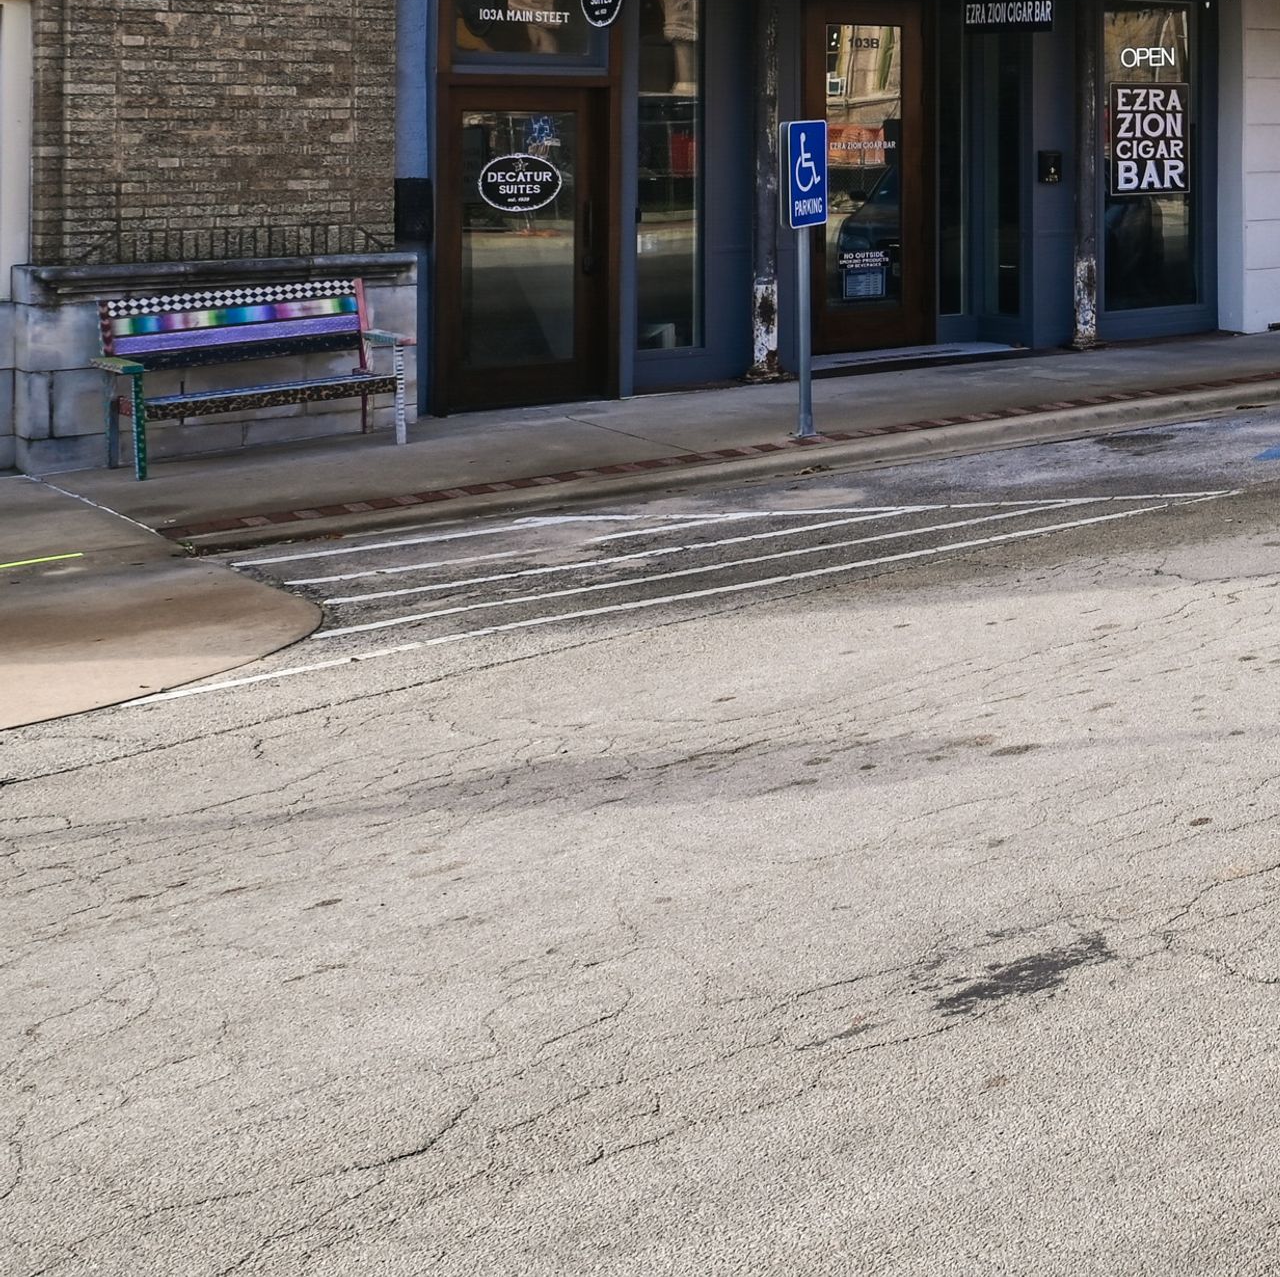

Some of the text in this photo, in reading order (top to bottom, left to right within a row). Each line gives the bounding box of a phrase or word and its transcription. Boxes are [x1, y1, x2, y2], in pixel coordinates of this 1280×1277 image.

[479, 8, 570, 23] 103A MAIN STEET
[965, 0, 1052, 24] EZRA ZION CIGAR BAR
[848, 38, 879, 49] 103B
[1121, 47, 1175, 68] OPEN
[1117, 88, 1184, 112] EZRA
[1116, 113, 1184, 138] ZION
[829, 141, 896, 150] EZRA ZION CIGAR BAR
[1116, 139, 1184, 159] CIGAR
[487, 171, 553, 183] DECATUR
[1117, 160, 1185, 191] BAR
[498, 184, 541, 195] SUITES
[794, 197, 823, 217] PARKING
[844, 251, 885, 260] NO OUTSIDE
